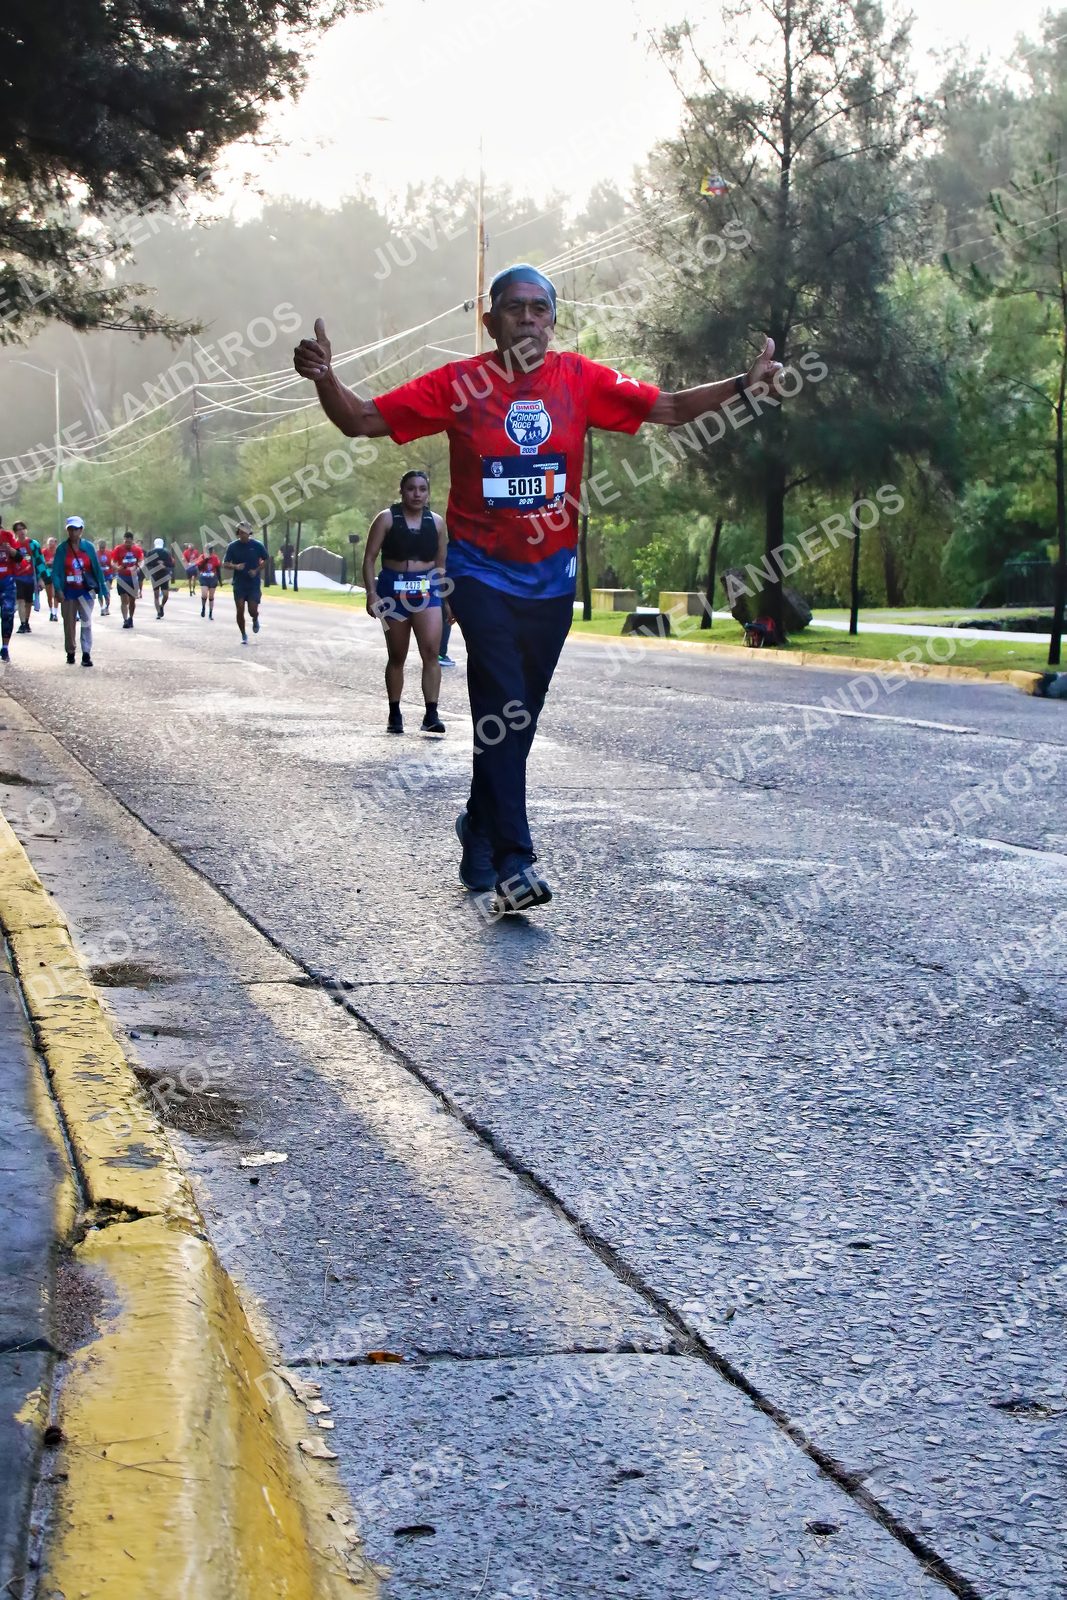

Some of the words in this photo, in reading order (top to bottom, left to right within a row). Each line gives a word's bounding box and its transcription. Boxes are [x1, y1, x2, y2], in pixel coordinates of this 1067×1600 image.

[516, 412, 540, 421] Global
[512, 420, 532, 429] Race
[508, 478, 542, 496] 5013
